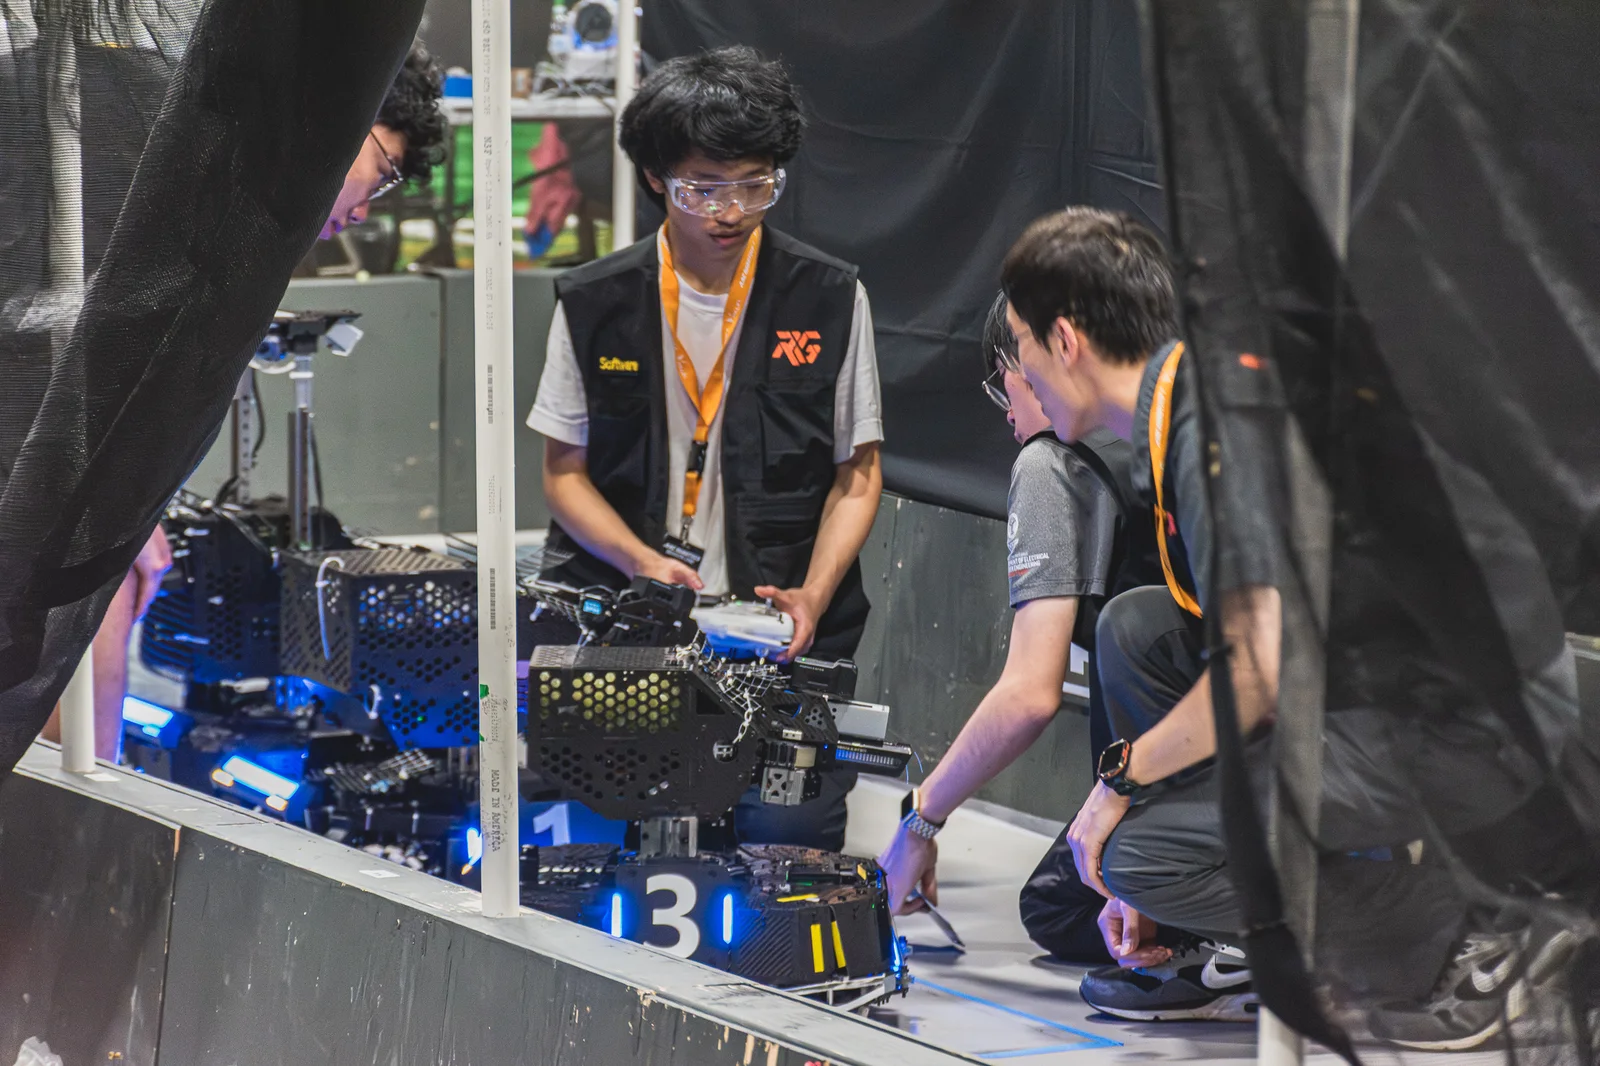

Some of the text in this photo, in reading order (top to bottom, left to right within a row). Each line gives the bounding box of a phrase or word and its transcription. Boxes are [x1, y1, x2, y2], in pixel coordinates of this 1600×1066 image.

[484, 136, 492, 156] NSF
[491, 769, 501, 852] MADE IN AMERICA
[533, 803, 571, 846] 1
[643, 874, 700, 959] 3
